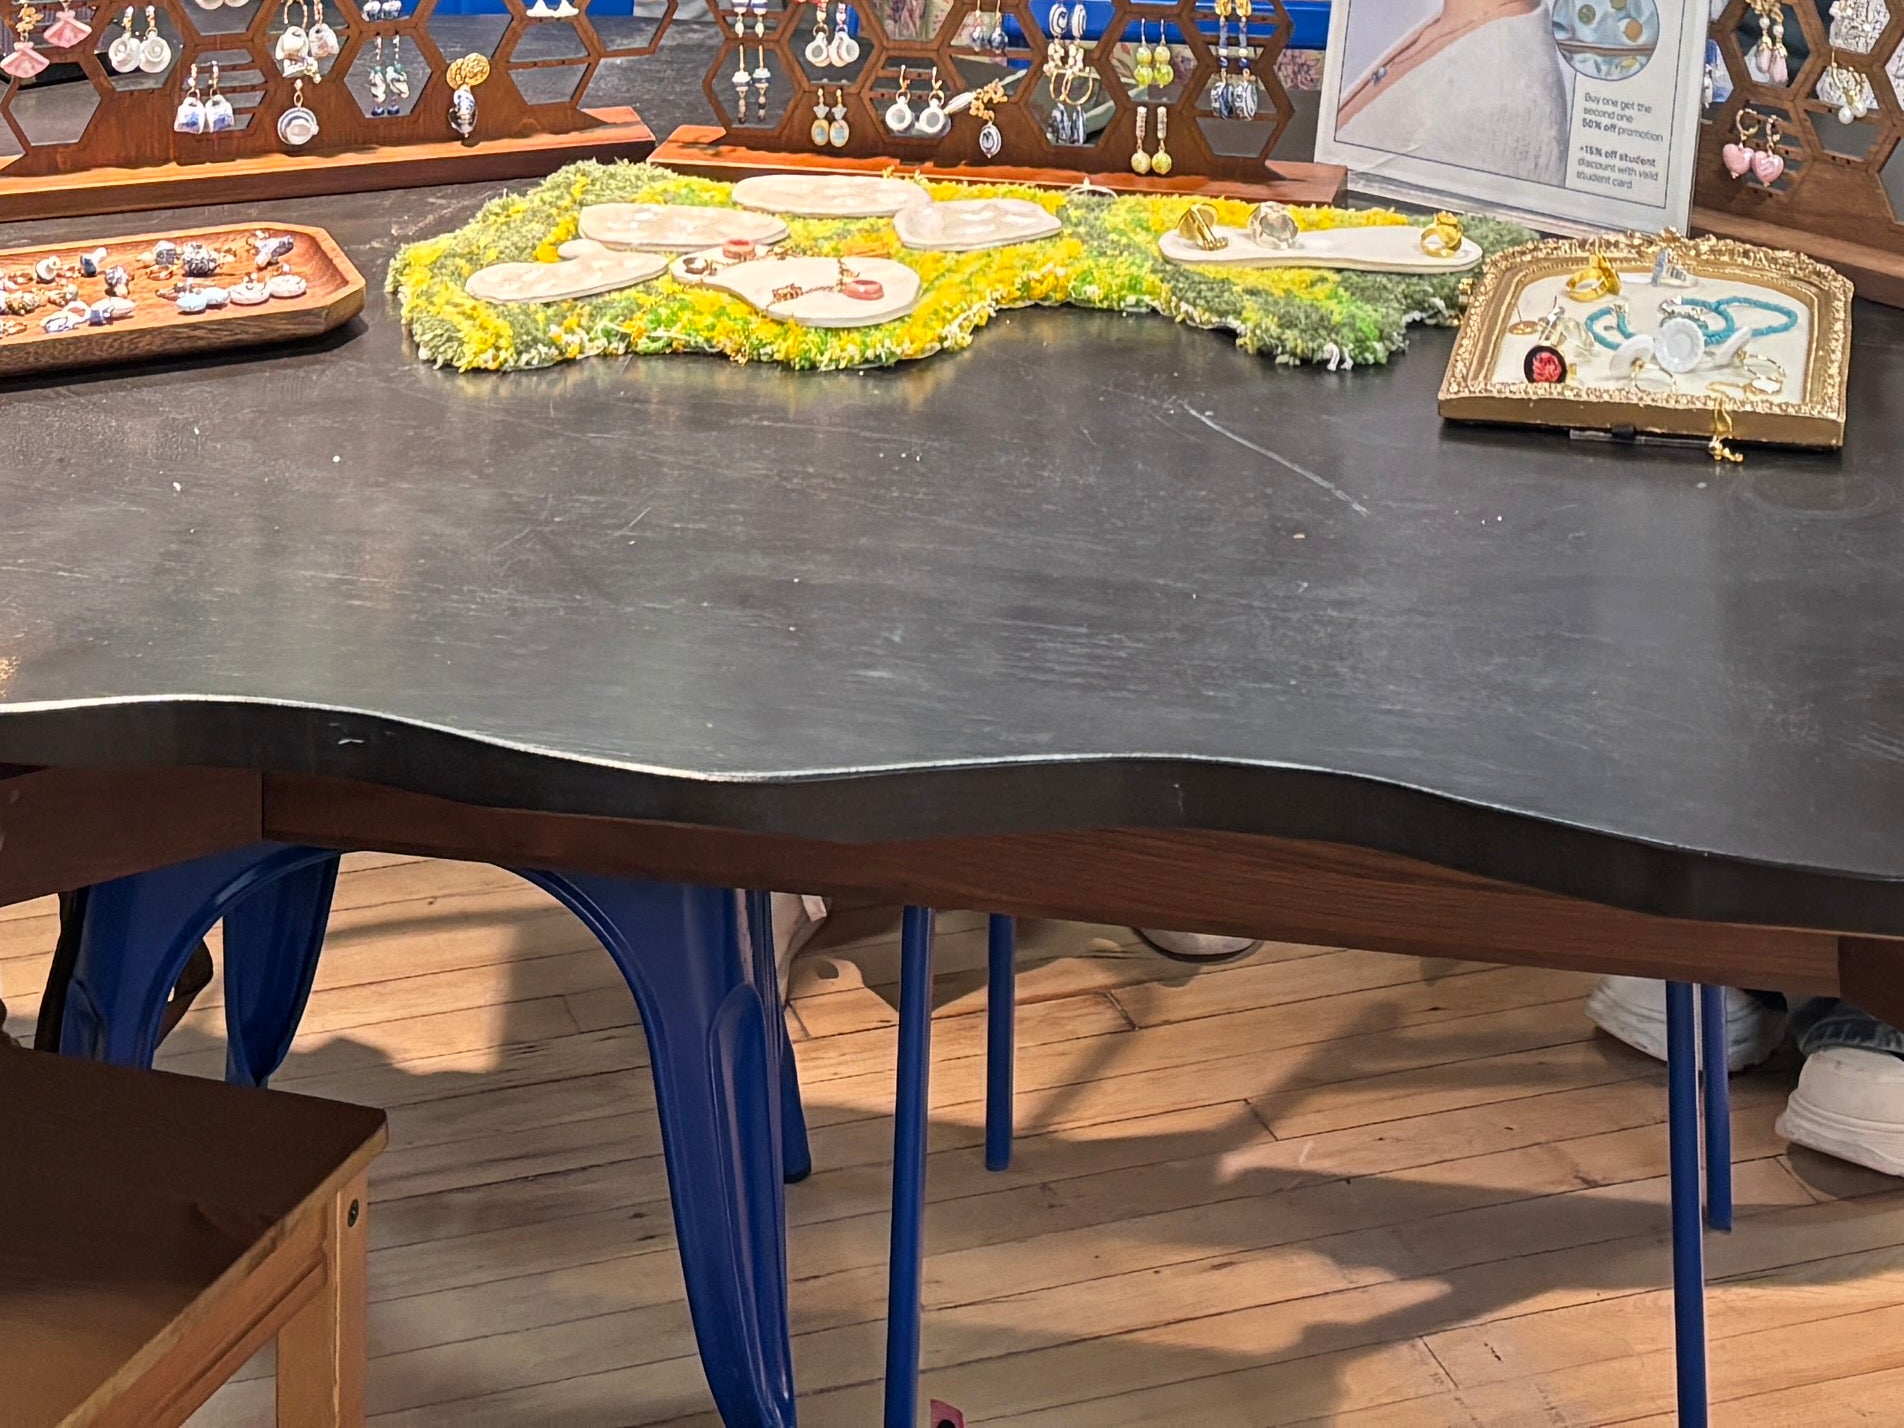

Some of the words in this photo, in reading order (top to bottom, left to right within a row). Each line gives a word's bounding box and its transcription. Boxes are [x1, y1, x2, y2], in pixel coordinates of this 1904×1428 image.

[1584, 92, 1601, 104] Buy
[1602, 97, 1618, 108] one
[1620, 100, 1635, 111] get
[1637, 103, 1653, 113] the
[1583, 107, 1615, 119] second
[1616, 113, 1633, 123] one
[1582, 117, 1602, 130] 50%
[1603, 123, 1616, 133] off
[1617, 127, 1663, 142] promotion
[1578, 157, 1616, 173] discount
[1617, 165, 1637, 176] with
[1604, 150, 1617, 159] off
[1619, 153, 1656, 167] student
[1612, 178, 1633, 189] card
